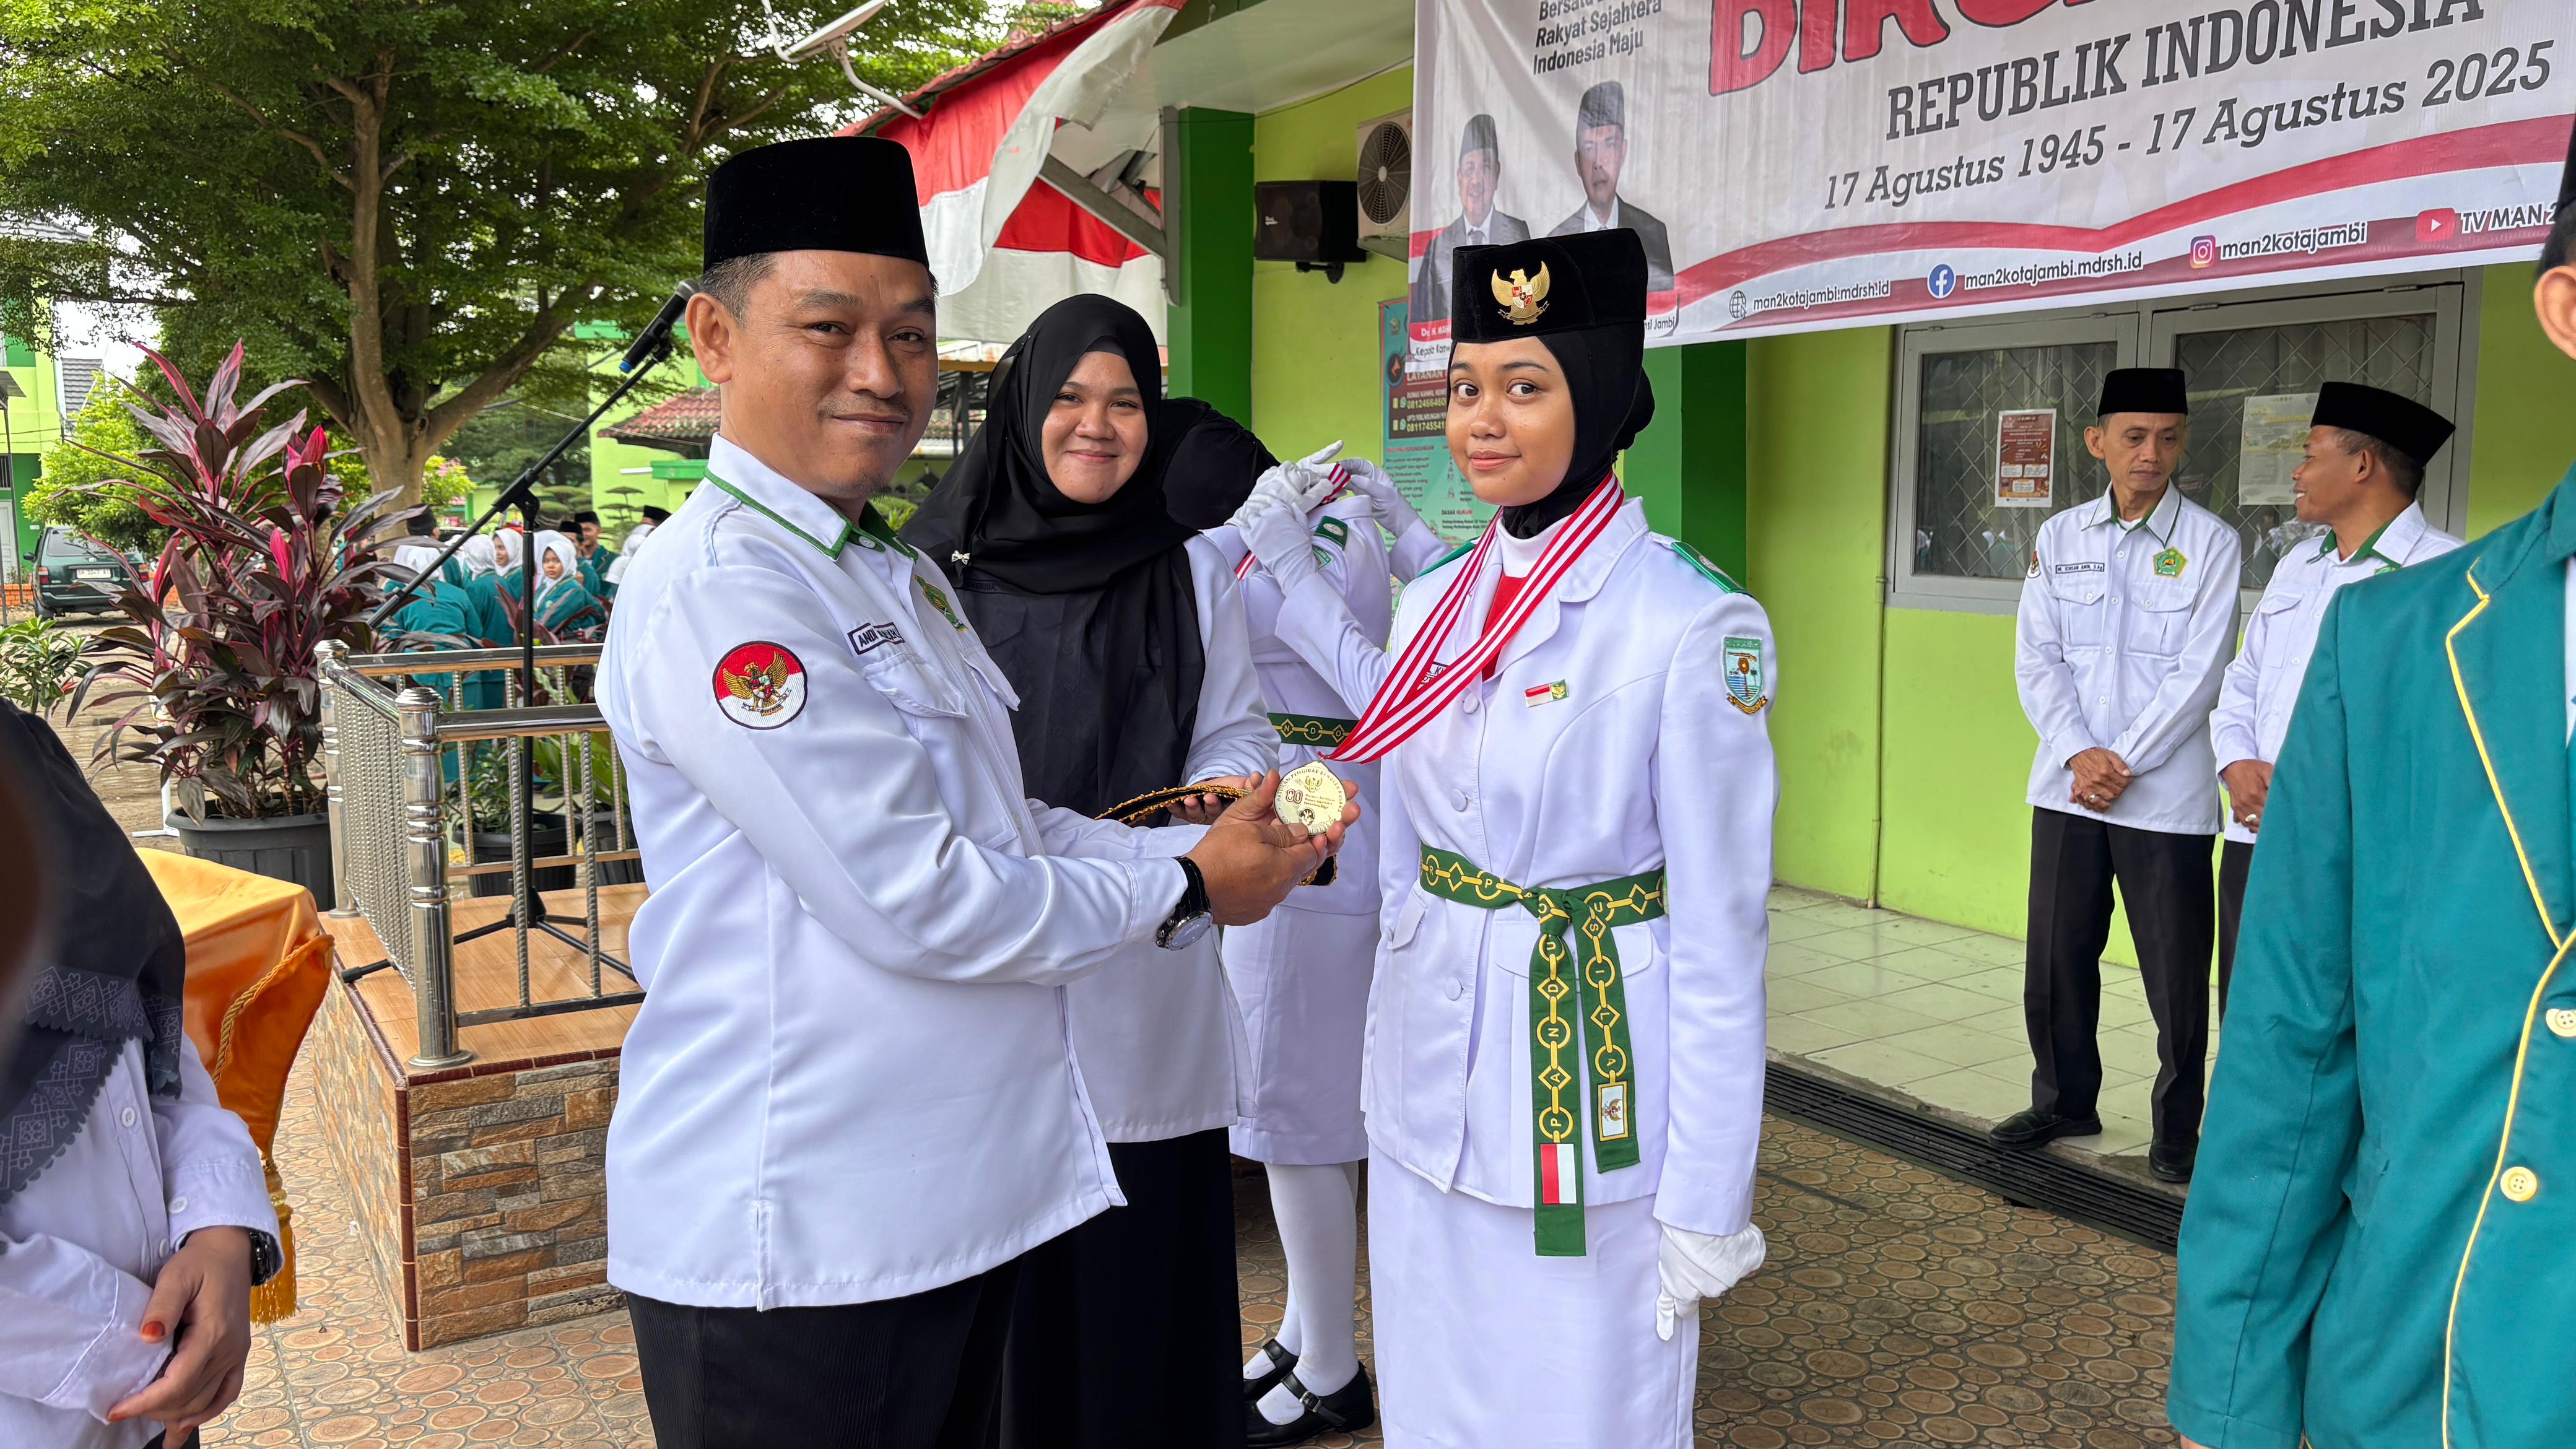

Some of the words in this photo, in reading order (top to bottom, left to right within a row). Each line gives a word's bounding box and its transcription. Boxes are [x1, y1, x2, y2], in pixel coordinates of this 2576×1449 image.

[1536, 17, 1586, 48] Rakyat
[1590, 0, 1662, 34] Sejahtera
[1533, 38, 1606, 75] Indonesia
[1609, 27, 1643, 56] Maju
[1886, 33, 2131, 141] REPUBLIK
[1824, 172, 1860, 210] 17
[1865, 155, 2005, 207] Agustus
[2018, 124, 2106, 178] 1945
[2146, 107, 2196, 155] 17
[2202, 81, 2406, 149] Agustus
[2421, 40, 2556, 108] 2025
[2463, 211, 2486, 232] TV
[2491, 204, 2543, 228] MAN
[2221, 223, 2367, 259] man2kotajambi
[1965, 251, 2143, 289] man2kotajambi.mdrsh.id
[1654, 316, 1675, 329] Jambi
[1286, 788, 1303, 804] 80
